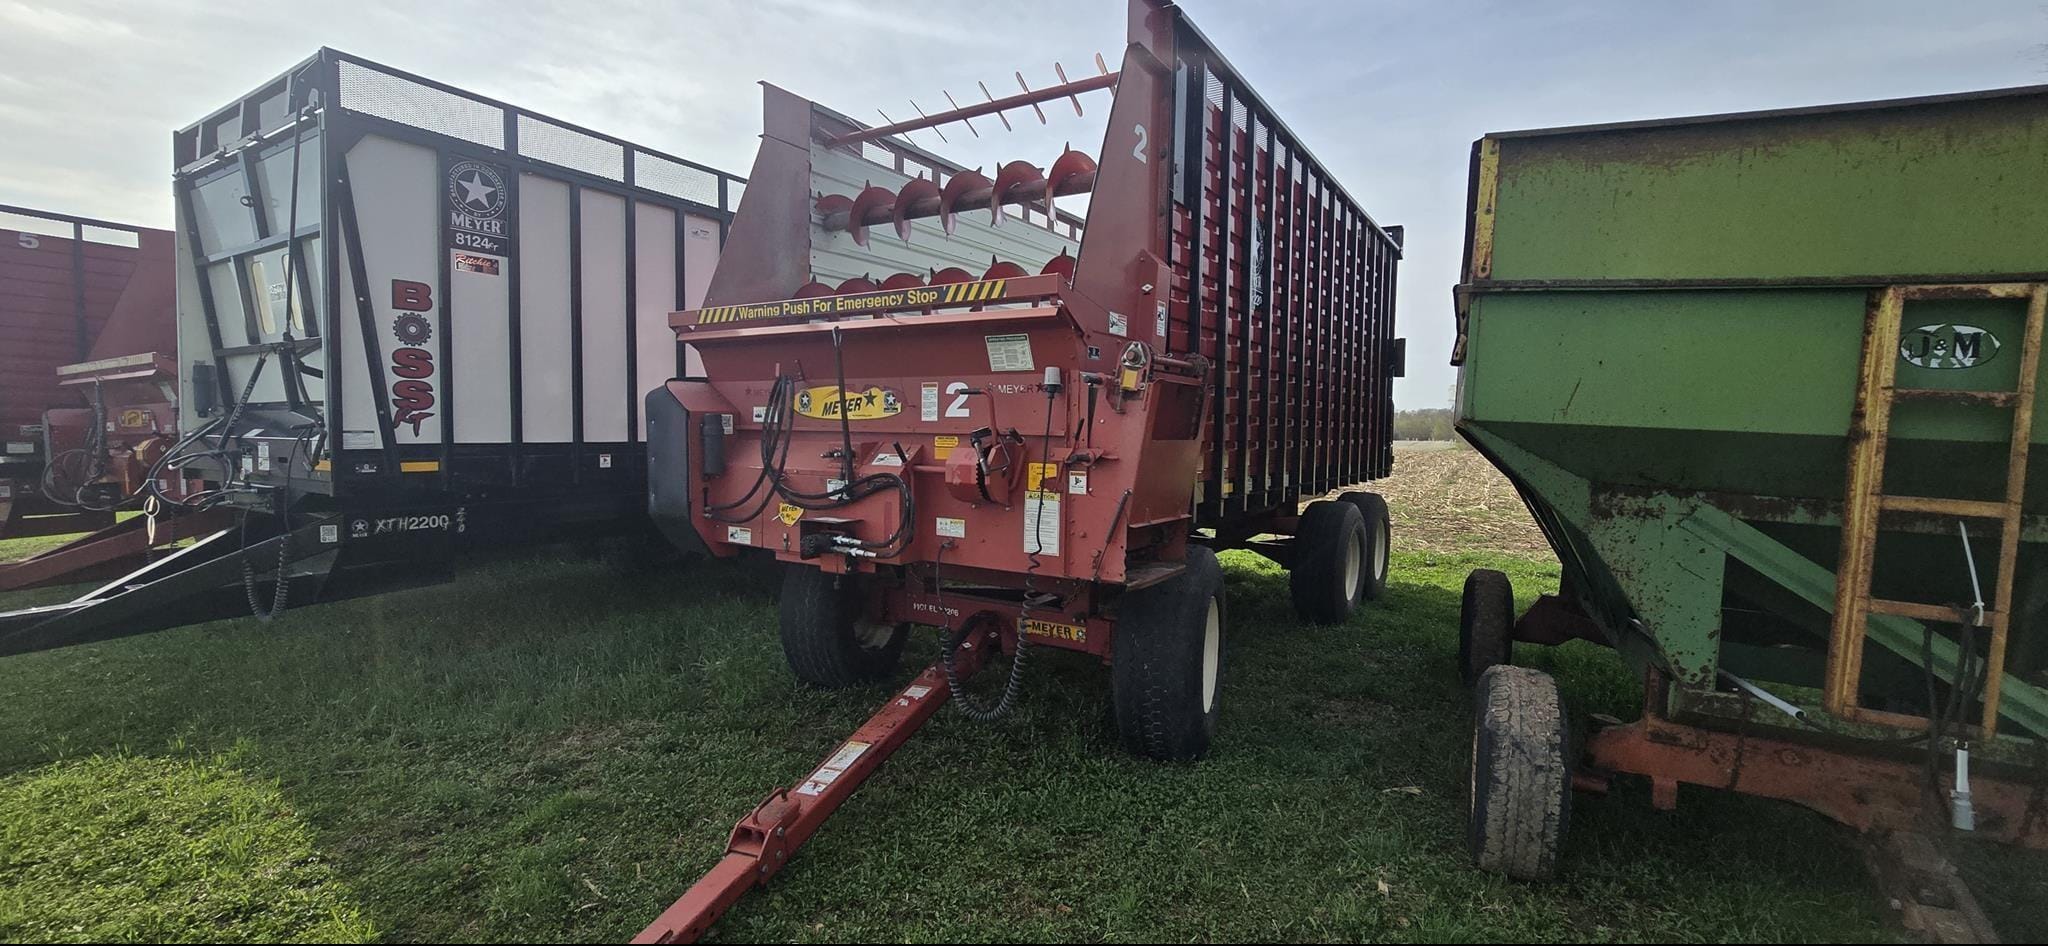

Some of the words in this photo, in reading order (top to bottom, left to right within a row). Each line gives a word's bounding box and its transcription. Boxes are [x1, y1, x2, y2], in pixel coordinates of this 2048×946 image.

[1132, 124, 1148, 164] 2
[451, 212, 501, 233] MEYER
[18, 232, 40, 249] 5
[738, 305, 780, 319] Warning
[783, 302, 810, 315] Push
[813, 300, 831, 312] For
[836, 293, 904, 311] Emergency
[907, 290, 938, 304] Stop
[945, 382, 970, 417] 2
[1032, 621, 1072, 639] MEYER
